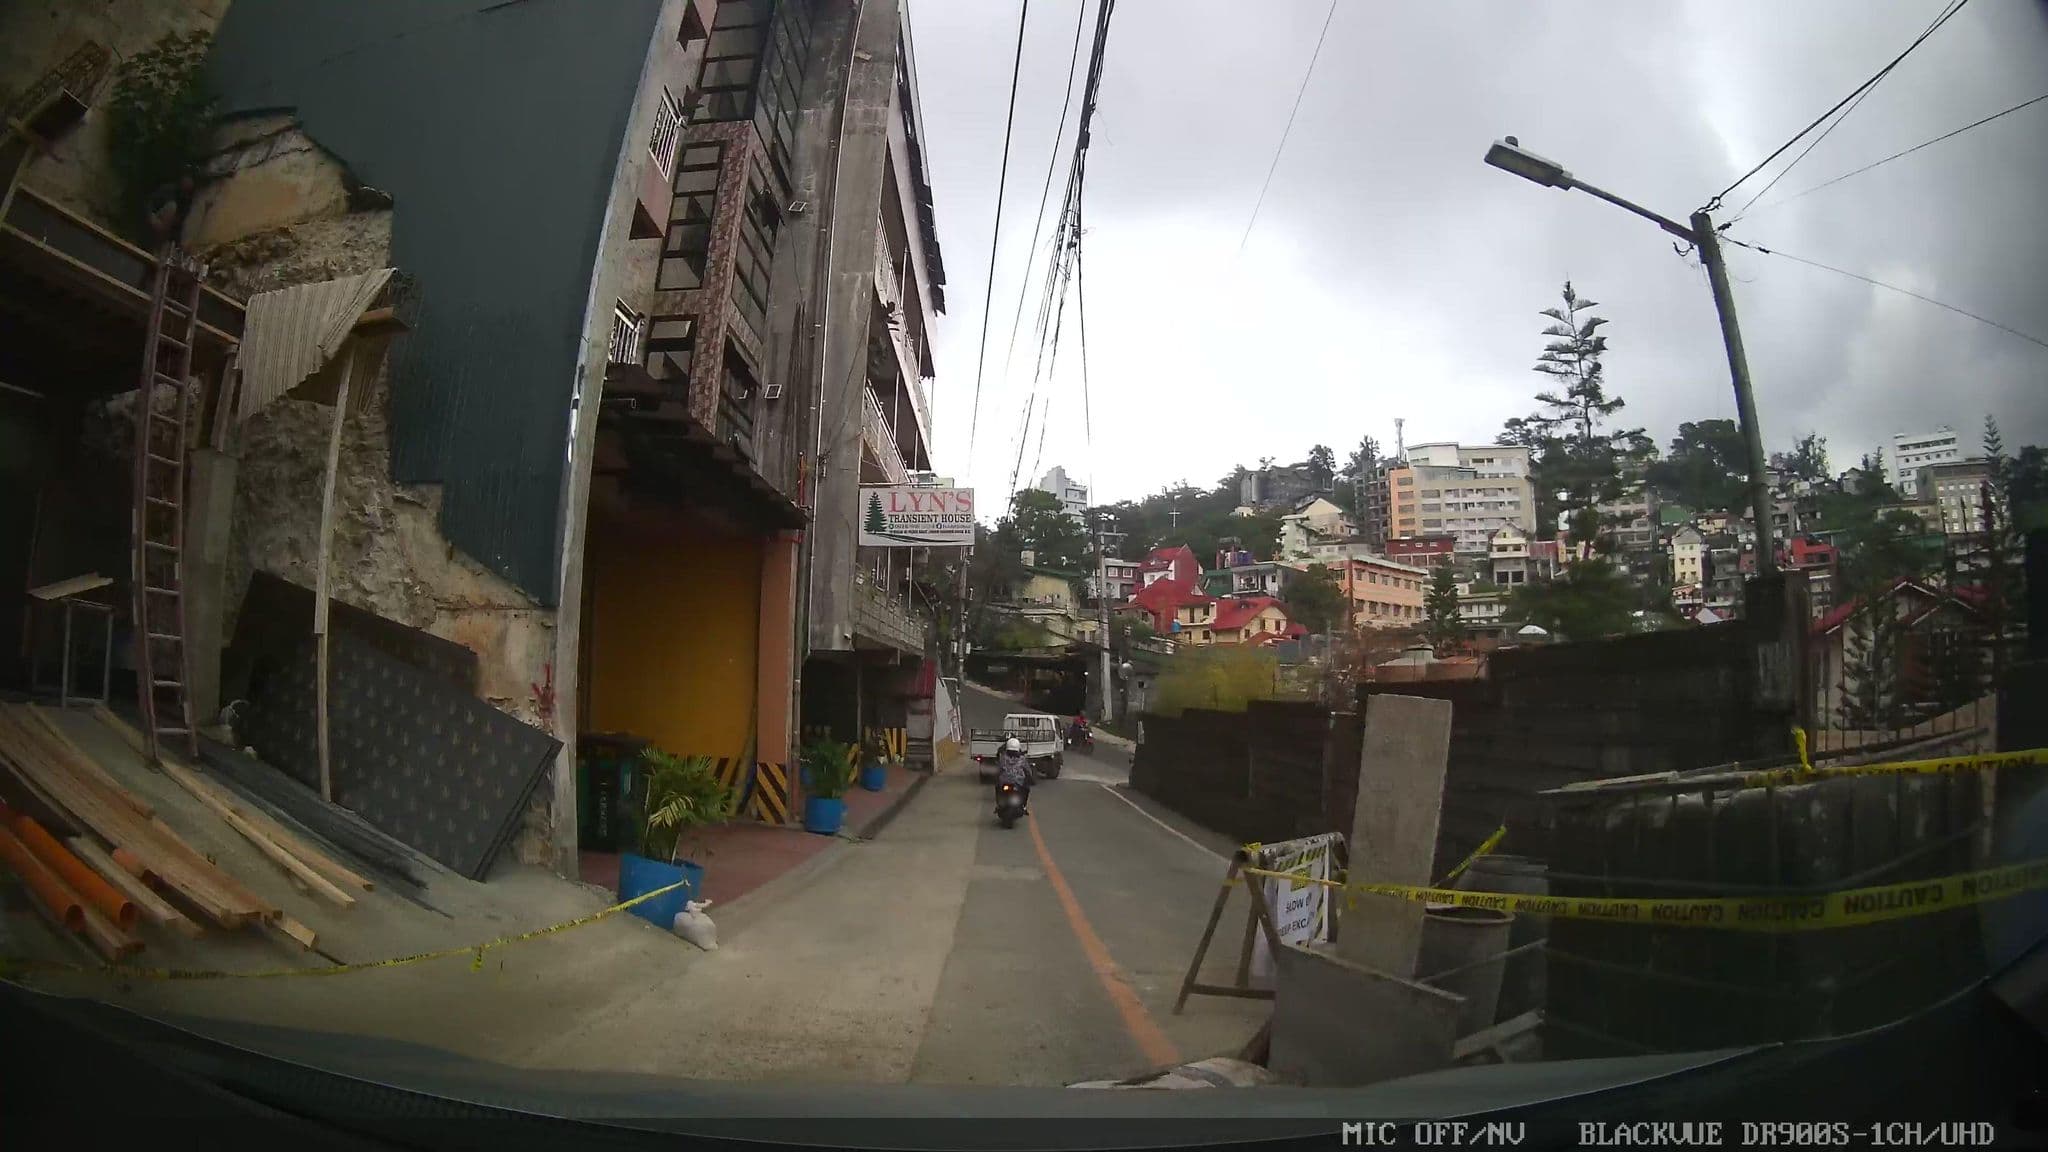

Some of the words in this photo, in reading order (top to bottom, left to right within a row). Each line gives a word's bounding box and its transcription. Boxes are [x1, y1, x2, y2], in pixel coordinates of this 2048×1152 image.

[888, 489, 972, 513] LYN'S
[888, 513, 939, 523] TRANSIENT
[941, 513, 972, 523] HOUSE
[1286, 897, 1304, 913] SLOW
[1415, 890, 1457, 905] CAUTION
[1461, 893, 1508, 909] CAUTION
[1515, 897, 1568, 914] CAUTION
[1578, 902, 1639, 920] CAUTION
[1652, 902, 1724, 921] CAUTION
[1738, 901, 1825, 921] CAUTION
[1844, 883, 1945, 914] CAUTION
